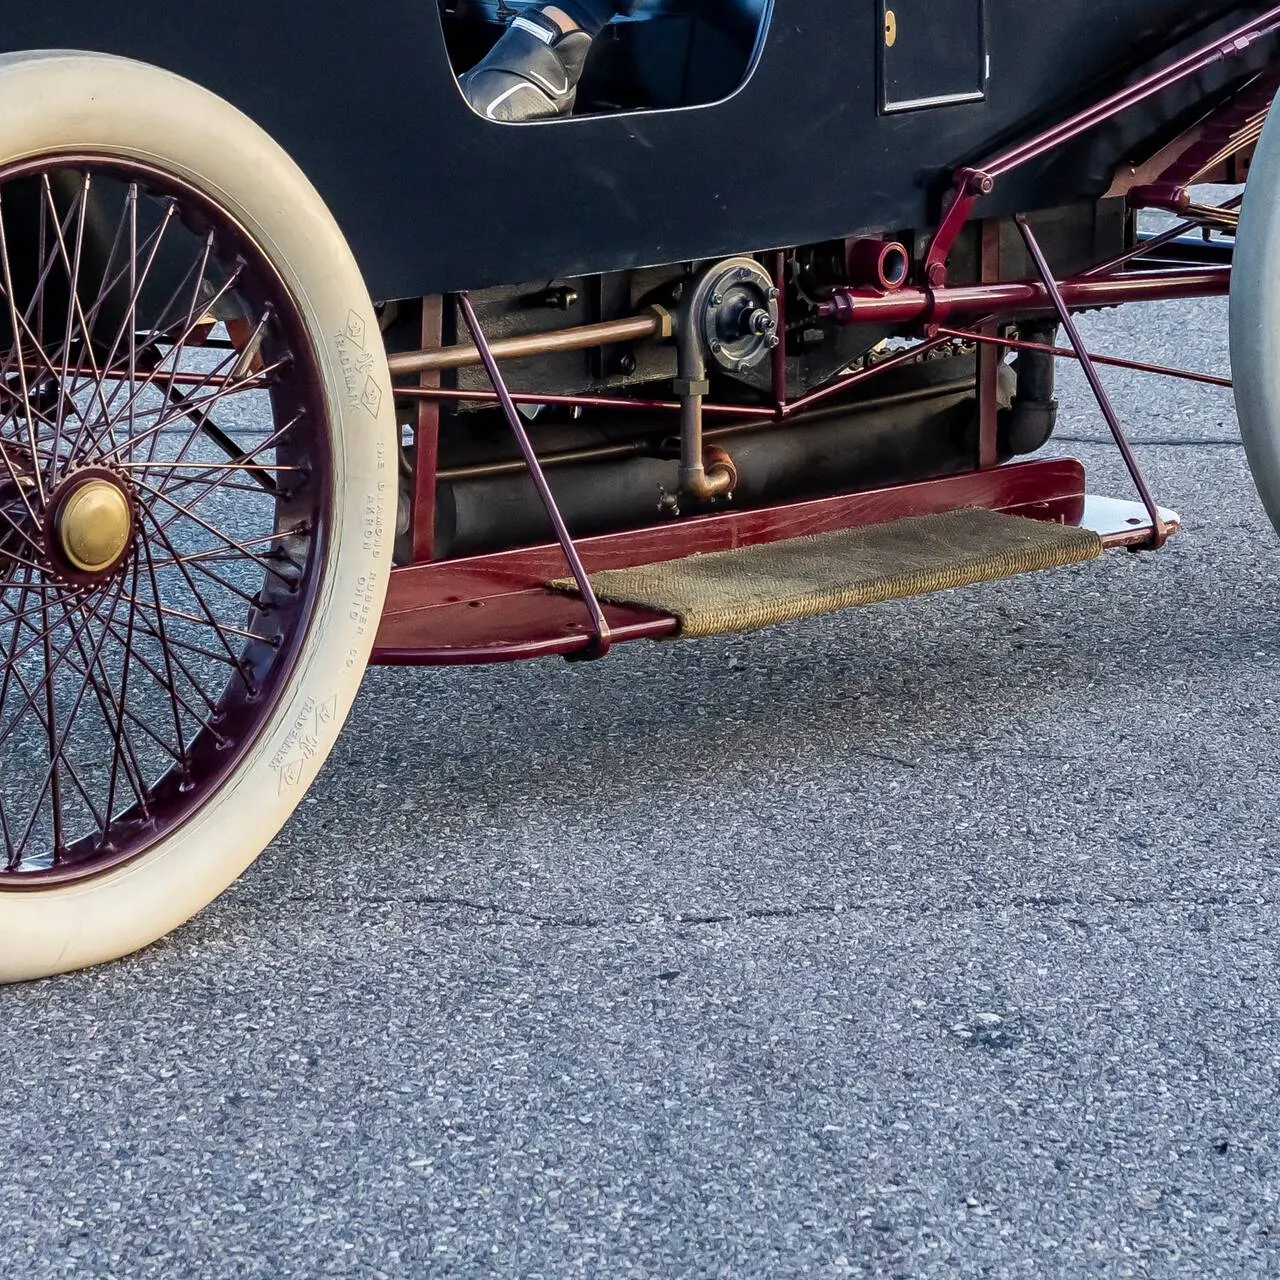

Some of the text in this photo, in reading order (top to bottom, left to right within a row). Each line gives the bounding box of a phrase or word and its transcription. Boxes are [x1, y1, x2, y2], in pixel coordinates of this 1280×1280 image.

[334, 330, 361, 414] TRADEMARK
[361, 494, 376, 551] AKRON
[372, 481, 386, 560] DIAMOND
[348, 576, 366, 620] OHIO
[357, 571, 377, 636] RUBBER
[267, 695, 316, 773] TRADEMARK
